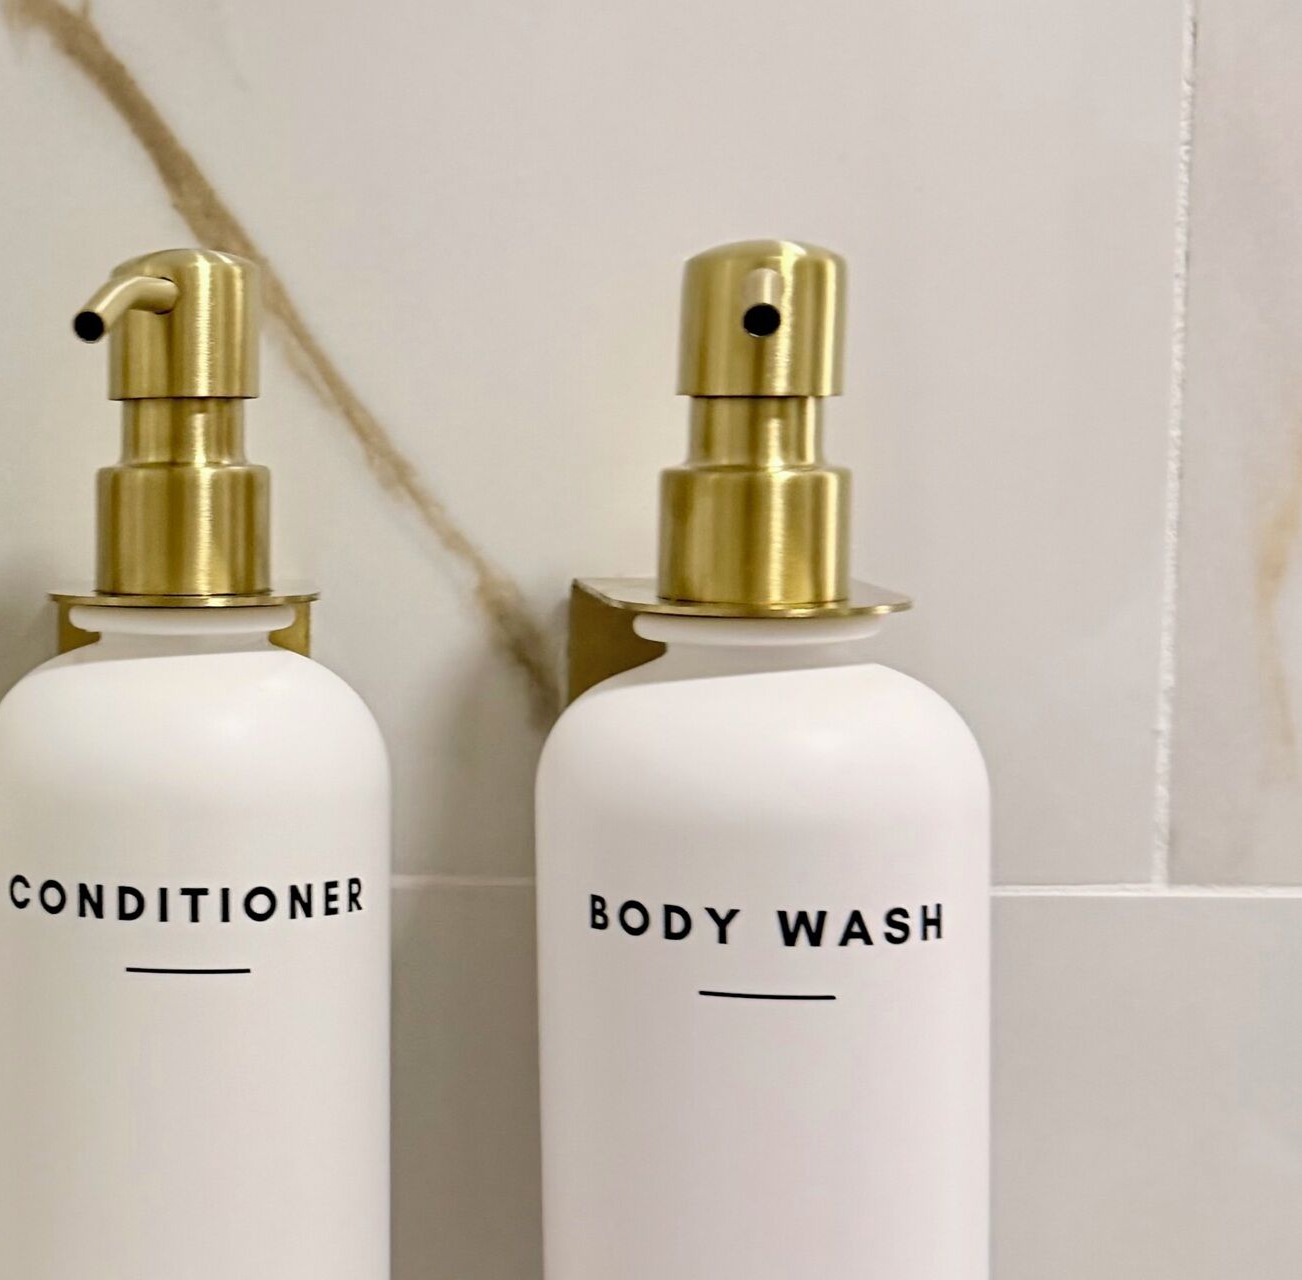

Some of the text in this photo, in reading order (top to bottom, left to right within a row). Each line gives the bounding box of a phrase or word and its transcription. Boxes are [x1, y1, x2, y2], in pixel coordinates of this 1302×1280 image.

[7, 872, 364, 925] CONDITIONER
[588, 892, 944, 949] BODY WASH
